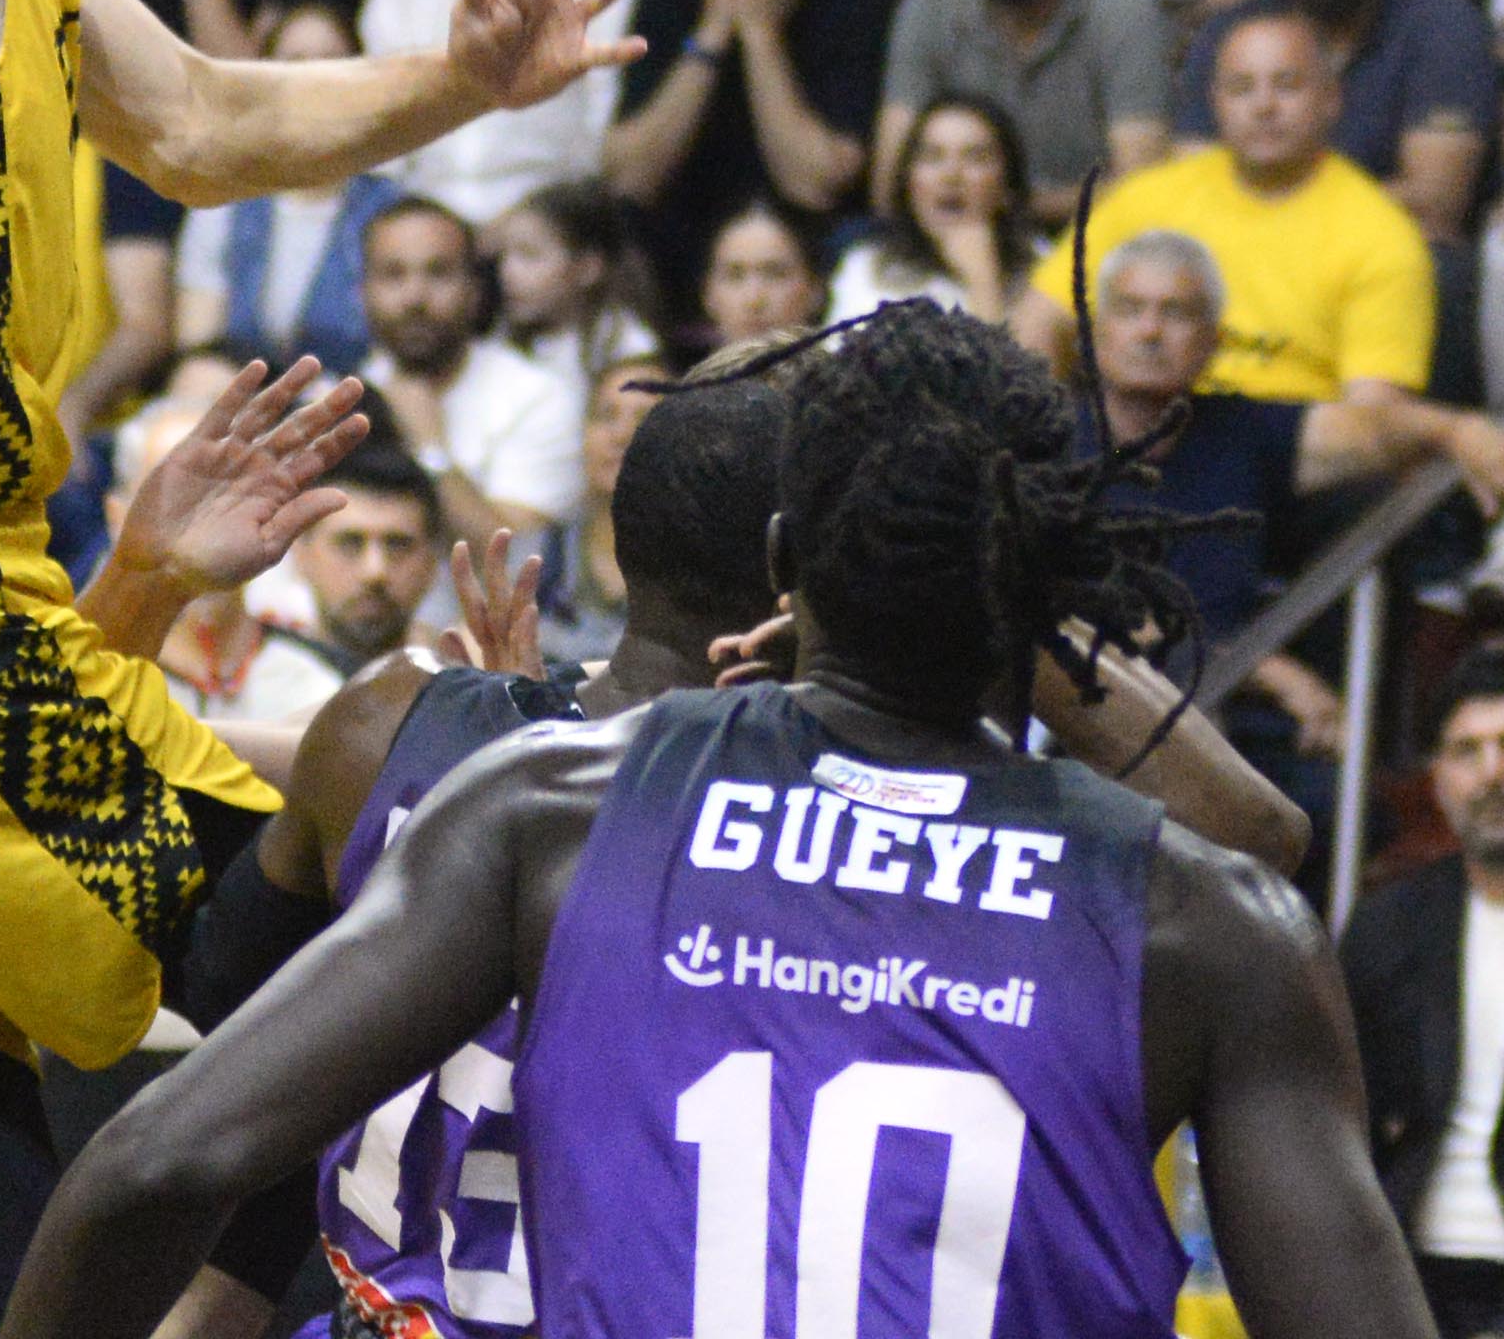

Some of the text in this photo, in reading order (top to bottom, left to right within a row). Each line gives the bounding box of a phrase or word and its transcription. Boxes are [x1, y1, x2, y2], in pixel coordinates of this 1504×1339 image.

[689, 780, 1065, 921] GUEYE
[733, 935, 1037, 1028] HangiKredi
[675, 1051, 1027, 1339] 10
